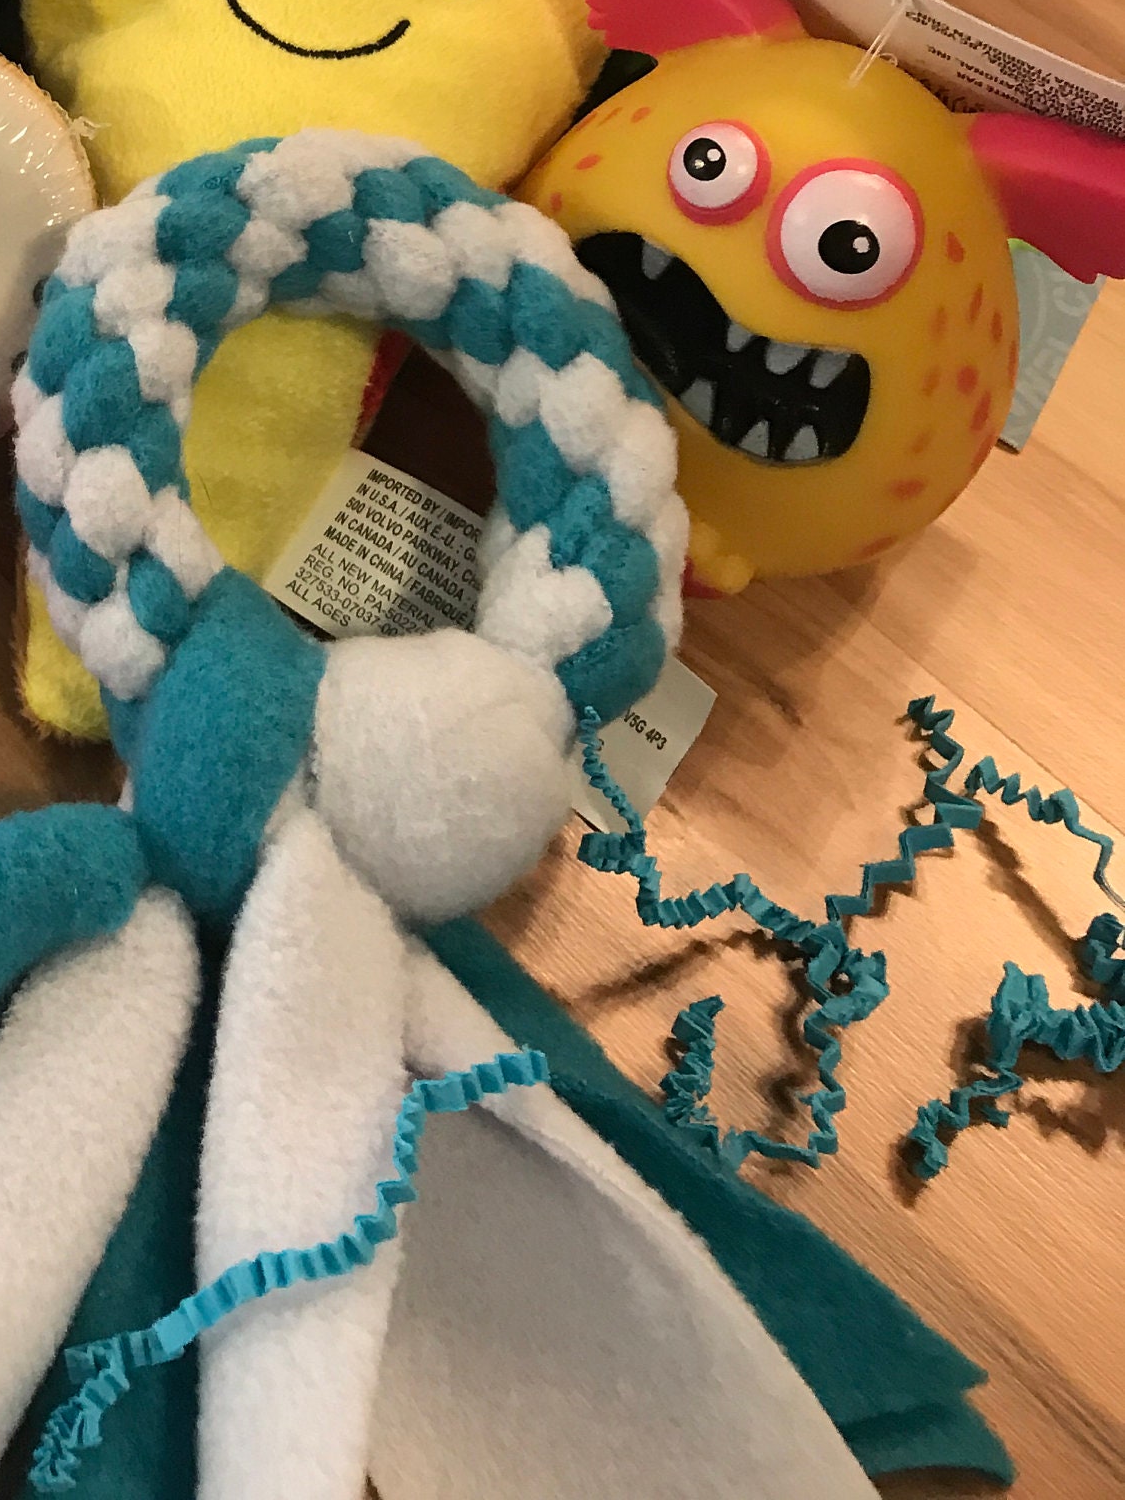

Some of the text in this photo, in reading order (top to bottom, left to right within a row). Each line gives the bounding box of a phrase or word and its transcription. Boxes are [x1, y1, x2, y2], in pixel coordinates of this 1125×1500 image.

[356, 482, 370, 497] IN
[369, 489, 397, 514] U.S.A.
[405, 511, 433, 533] AUX
[366, 468, 423, 505] IMPORTED
[421, 497, 441, 515] BY
[334, 511, 349, 526] IN
[348, 519, 394, 555] CANADA
[399, 550, 418, 569] AU
[417, 562, 465, 602] CANADA
[345, 497, 366, 514] 500
[365, 503, 404, 537] VOLVO
[402, 529, 460, 578] PARKWAY,
[303, 554, 334, 582] REG.
[337, 575, 361, 601] NO.
[311, 543, 336, 565] ALL
[338, 557, 373, 585] NEW
[371, 579, 437, 631] MATERIAL
[323, 525, 358, 553] MADE
[355, 544, 371, 561] IN
[369, 553, 405, 586] CHINA
[410, 580, 468, 627] FABRIQUÉ
[285, 579, 352, 628] ALL AGES
[645, 728, 668, 751] 4P3
